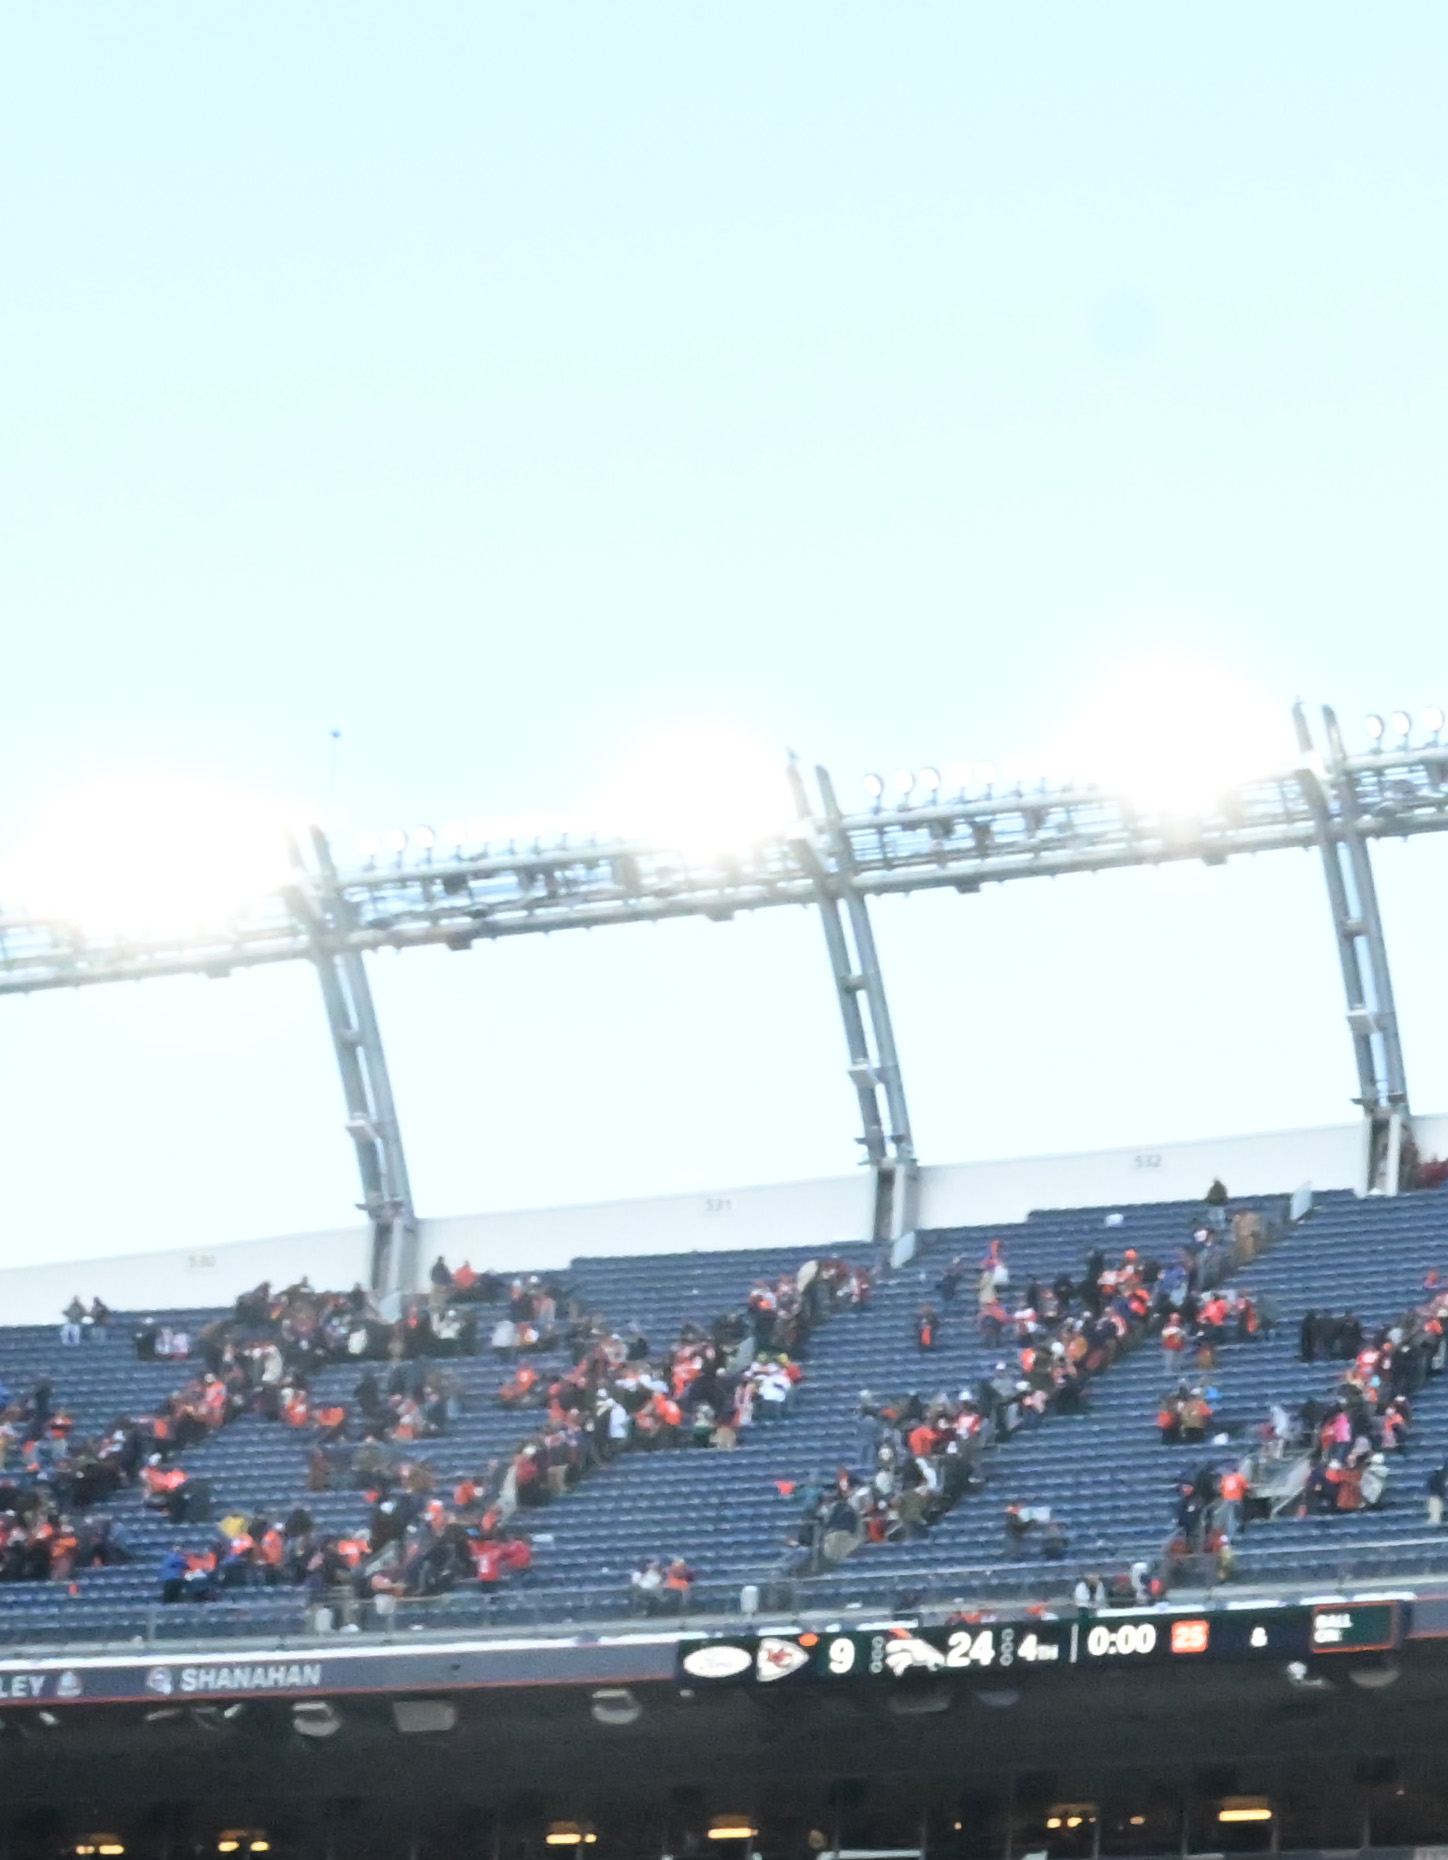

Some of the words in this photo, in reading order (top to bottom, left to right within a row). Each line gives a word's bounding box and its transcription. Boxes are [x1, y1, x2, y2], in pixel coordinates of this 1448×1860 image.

[829, 1637, 855, 1675] 9
[947, 1630, 995, 1668] 24
[1088, 1623, 1156, 1656] 0:00
[1174, 1625, 1206, 1650] 25
[181, 1663, 322, 1692] SHANAHAN
